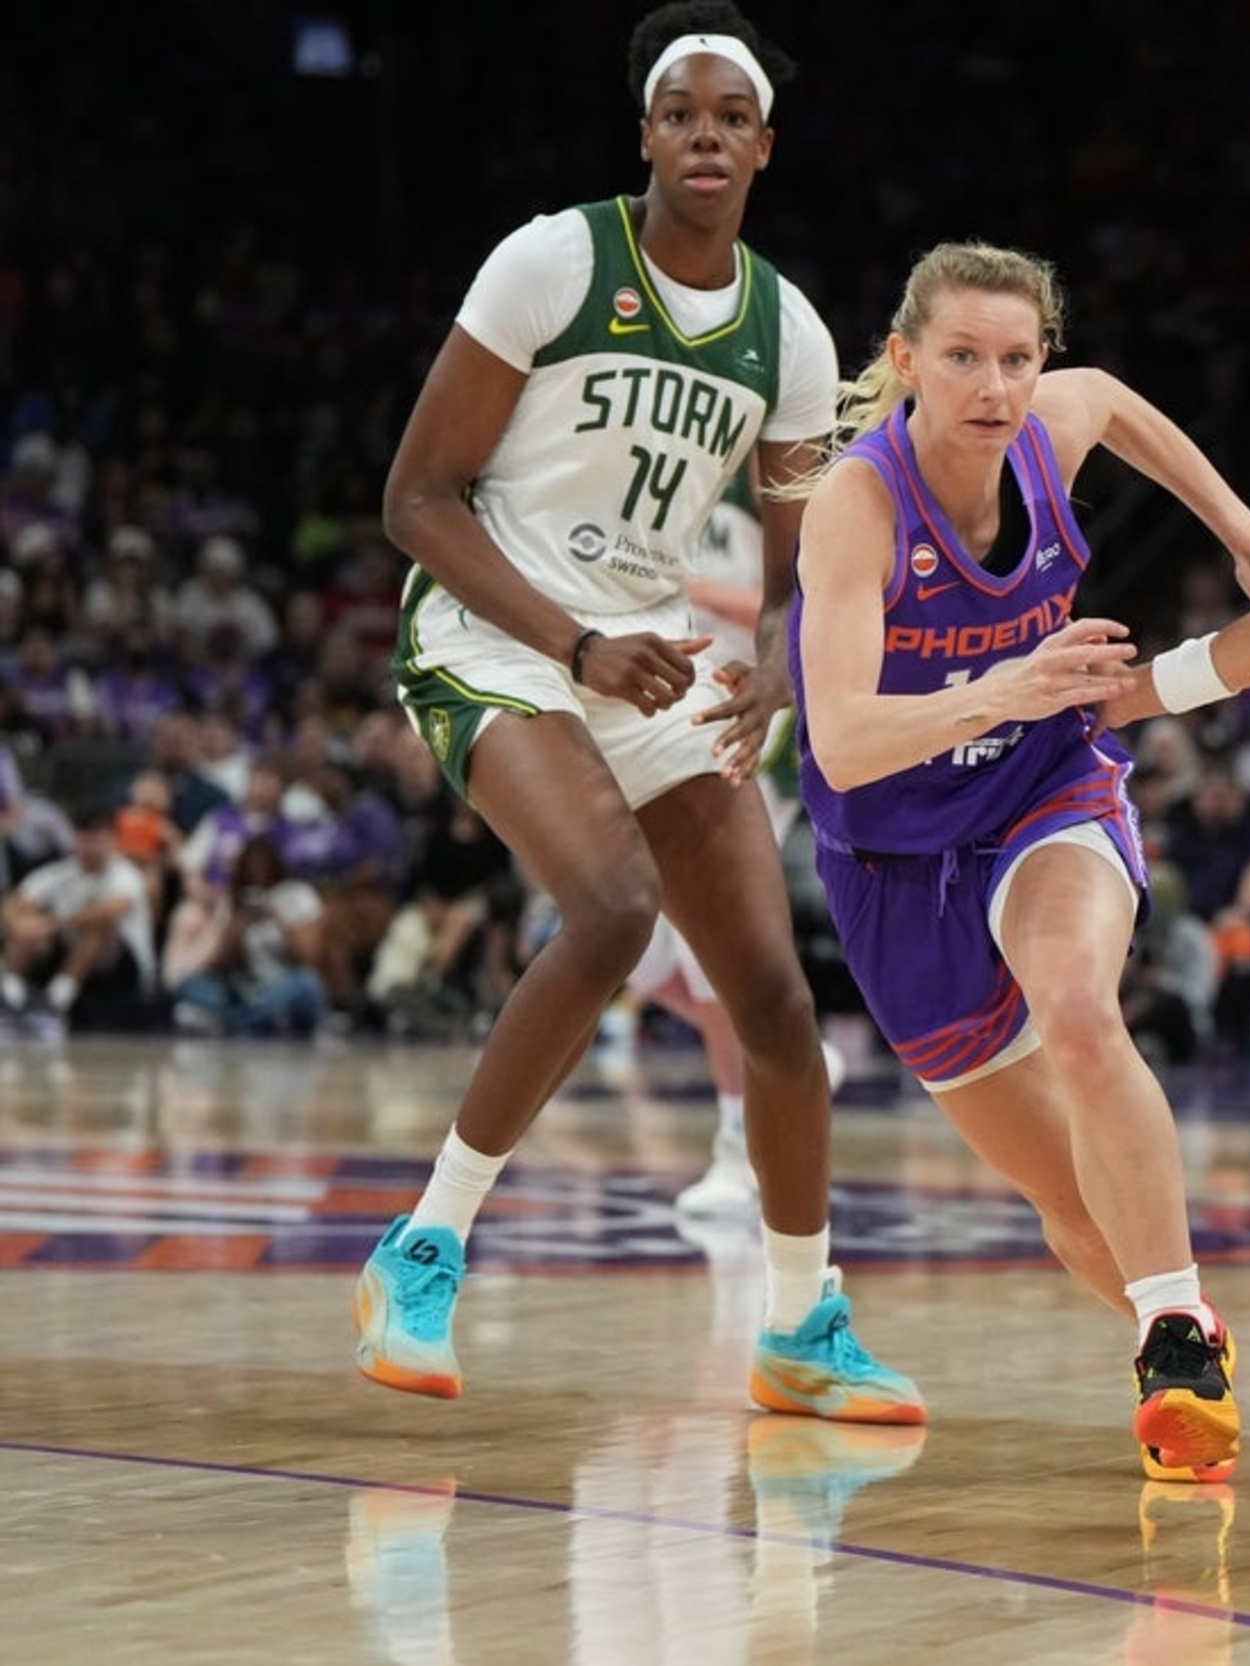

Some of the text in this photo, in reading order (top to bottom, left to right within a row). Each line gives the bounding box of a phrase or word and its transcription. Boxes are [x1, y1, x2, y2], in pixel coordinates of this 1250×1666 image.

[574, 367, 747, 466] STORM
[620, 445, 688, 532] 14
[885, 582, 1078, 658] PHOENIX
